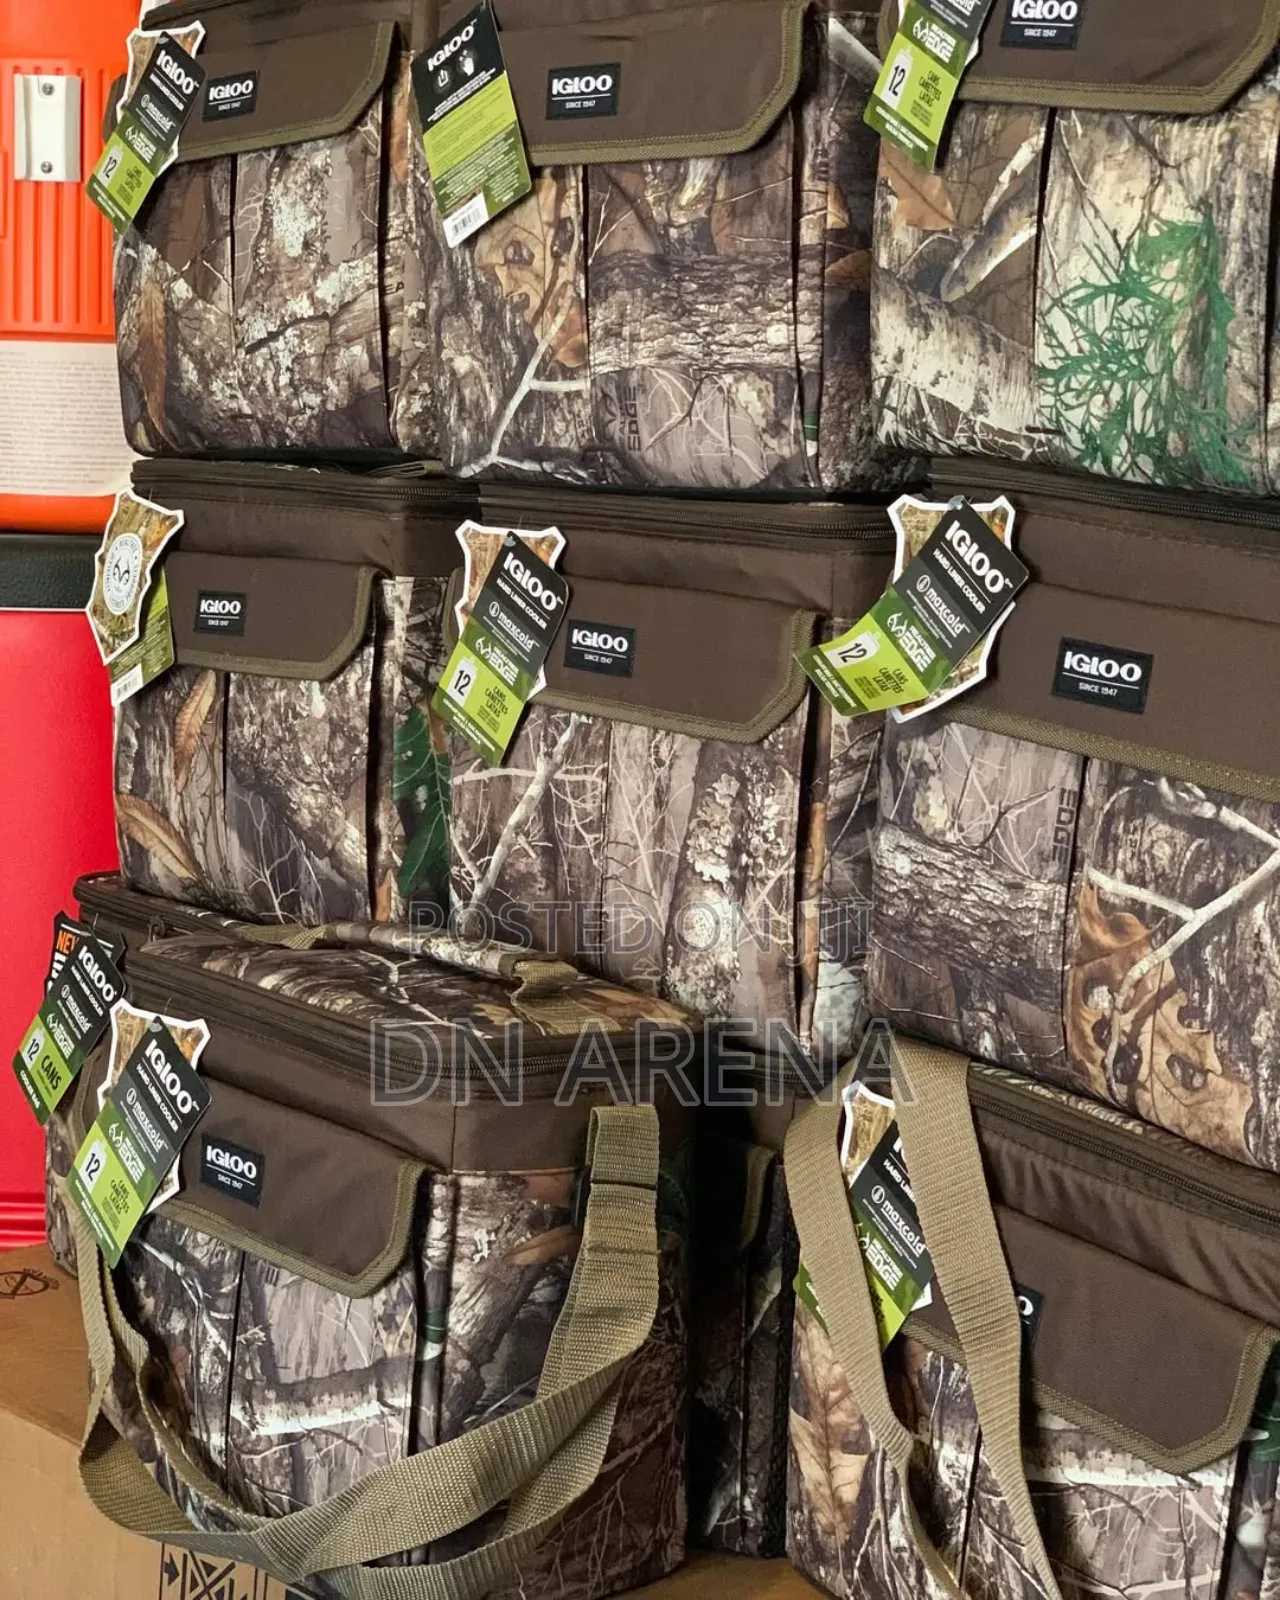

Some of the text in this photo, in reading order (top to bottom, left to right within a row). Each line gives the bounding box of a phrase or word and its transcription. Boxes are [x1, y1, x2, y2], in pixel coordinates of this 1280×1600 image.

[1011, 0, 1078, 20] IGLOO
[427, 25, 474, 71] IGLOO
[925, 35, 954, 64] EDGE
[155, 50, 195, 95] IGLOO
[552, 75, 612, 95] IGLOO
[887, 65, 906, 97] 12
[209, 80, 253, 101] IGLOO
[103, 156, 117, 179] 12
[945, 519, 1004, 594] IGLOO
[503, 551, 557, 611] IGLOO
[933, 548, 986, 614] HARD LINER COOLER
[200, 599, 241, 615] IGLOO
[496, 578, 512, 597] HARD
[524, 605, 548, 631] COOLER
[925, 588, 964, 637] maxcold
[497, 611, 534, 652] maxcold
[572, 629, 629, 653] IGLOO
[488, 652, 517, 687] EDGE
[838, 643, 867, 663] 12
[898, 632, 933, 673] EDGE
[1063, 650, 1143, 682] IGLOO
[453, 670, 471, 697] 12
[493, 685, 507, 702] CANS
[892, 667, 909, 685] CANS
[1078, 682, 1118, 697] SINCE 1947
[1052, 787, 1077, 864] EDGE
[78, 945, 115, 1003] IGLOO
[26, 1038, 40, 1063] 12
[54, 1031, 73, 1060] EDGE
[40, 1055, 62, 1090] CANS
[145, 1038, 193, 1115] IGLOO
[133, 1101, 164, 1153] maxcold
[158, 1101, 179, 1133] COOLER
[86, 1152, 100, 1182] 12
[119, 1147, 142, 1185] EDGE
[207, 1145, 257, 1180] IGLOO
[883, 1159, 902, 1184] HARD
[900, 1180, 916, 1203] LINE
[882, 1200, 926, 1258] maxcold
[866, 1246, 898, 1291] EDGE
[872, 1237, 903, 1280] REALTREE
